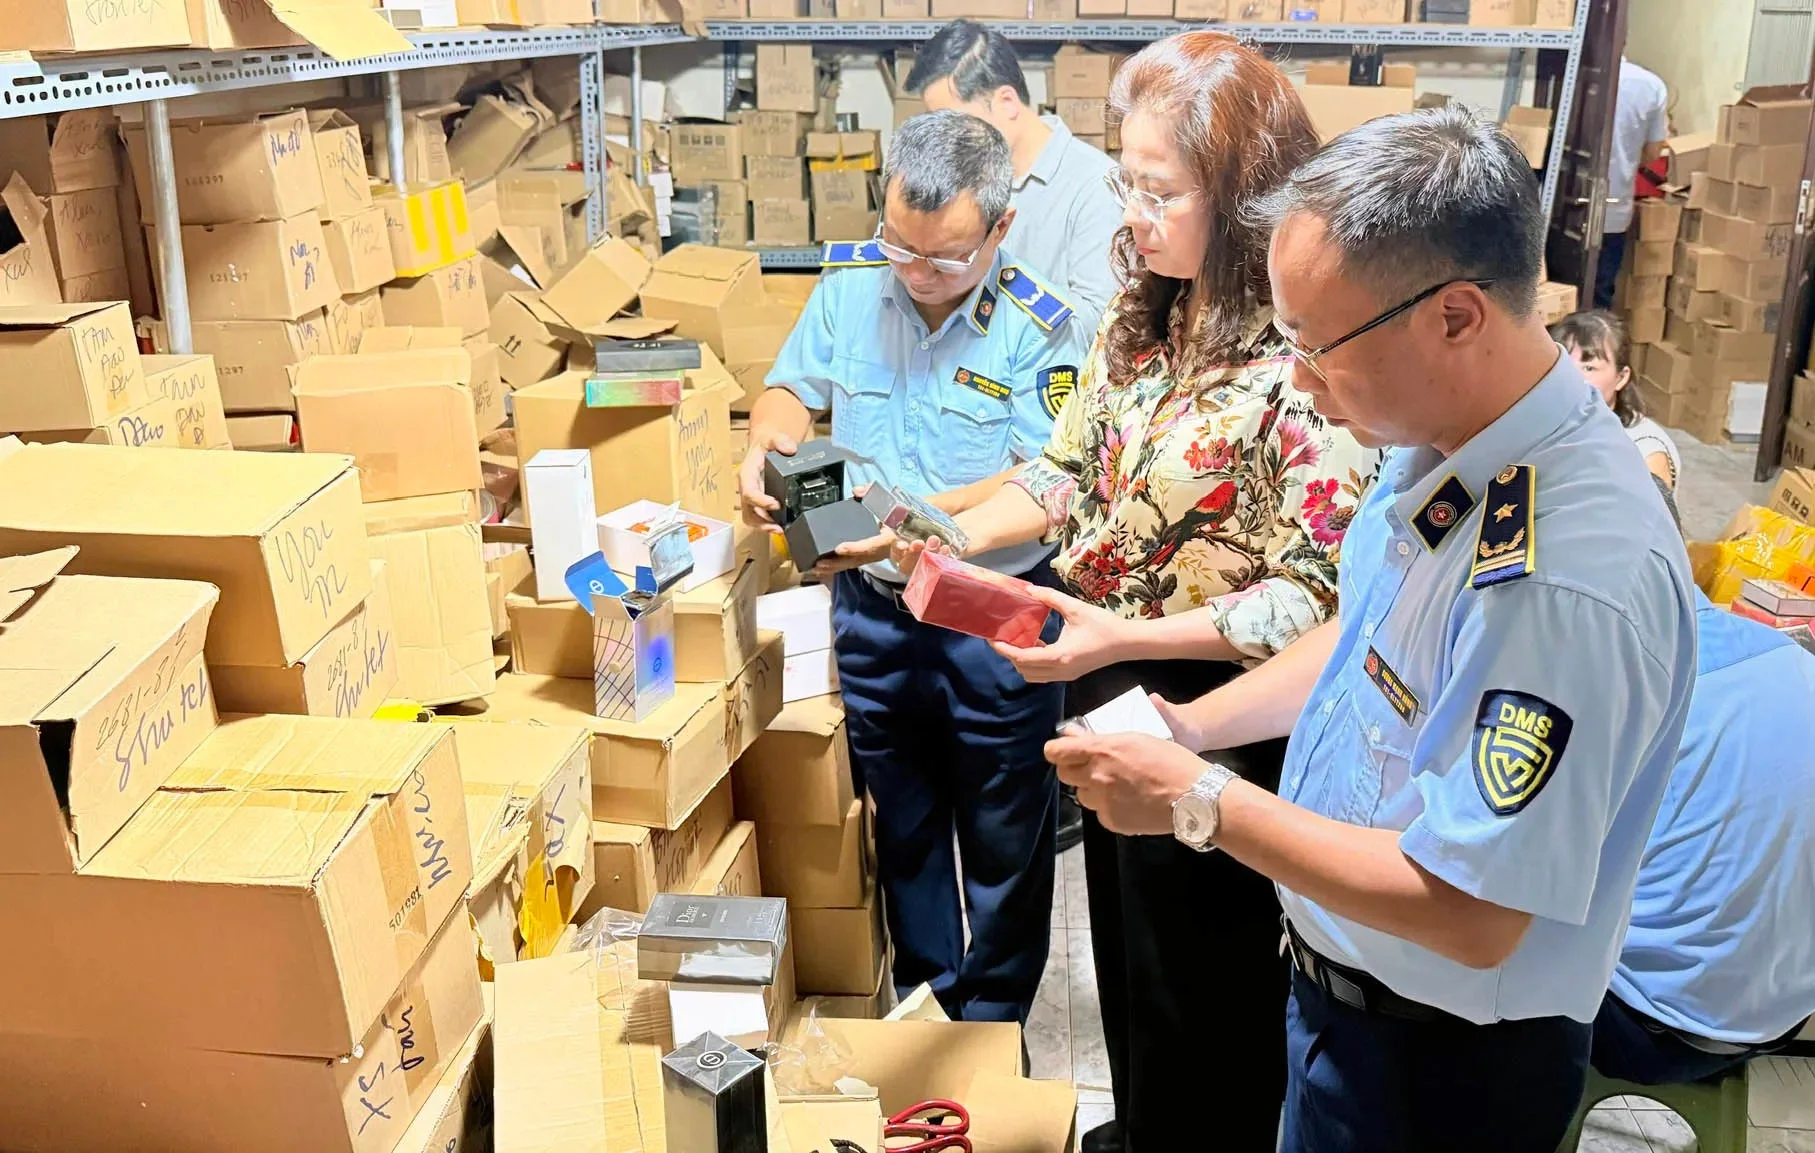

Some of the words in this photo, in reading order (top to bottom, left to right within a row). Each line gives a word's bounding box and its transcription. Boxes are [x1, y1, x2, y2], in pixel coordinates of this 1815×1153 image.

[1049, 371, 1073, 384] DMS
[1498, 701, 1553, 739] DMS
[675, 904, 696, 924] Dior
